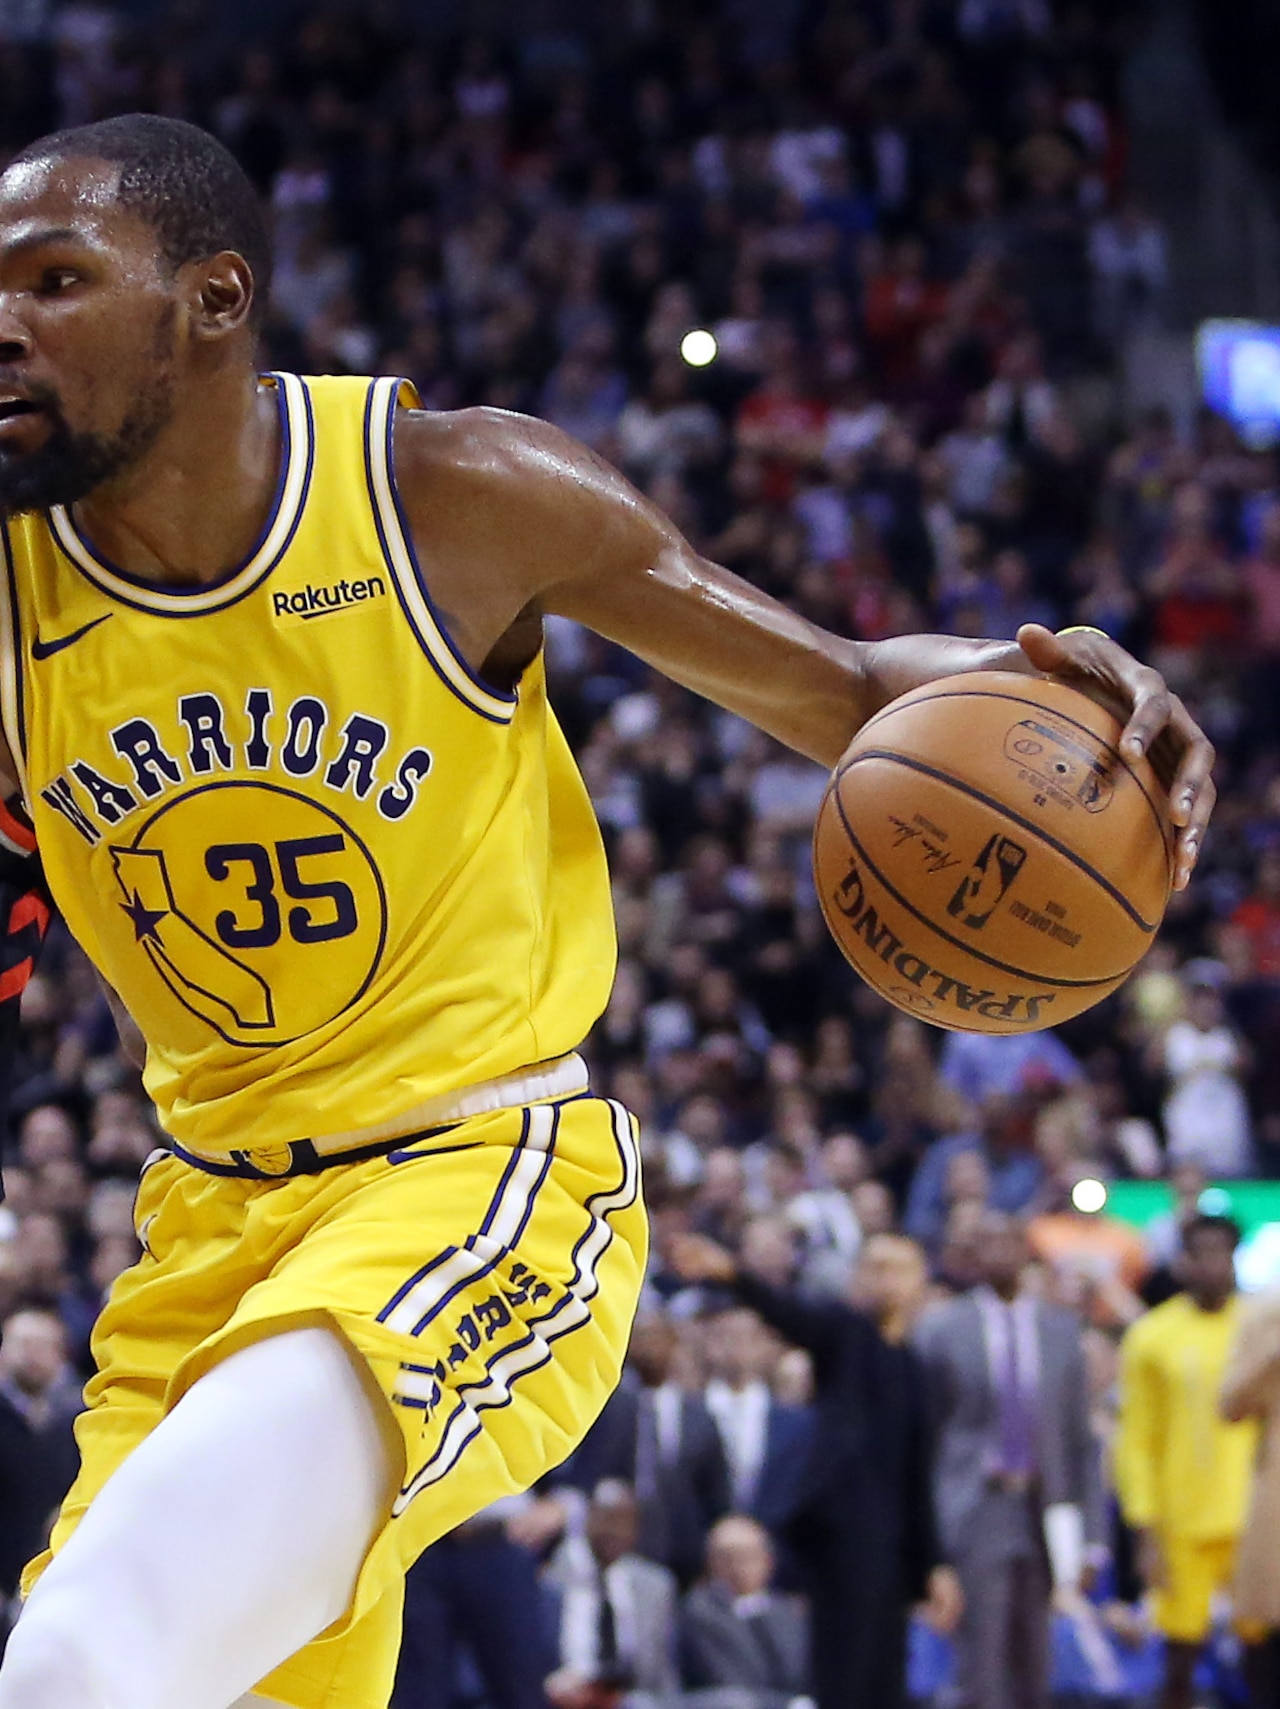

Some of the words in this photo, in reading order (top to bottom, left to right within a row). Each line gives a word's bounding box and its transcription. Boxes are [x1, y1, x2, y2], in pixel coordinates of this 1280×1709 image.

[273, 576, 386, 620] Rakuten
[40, 687, 433, 846] WARRIORS
[204, 833, 359, 949] 35
[832, 862, 1057, 1024] SPALDING
